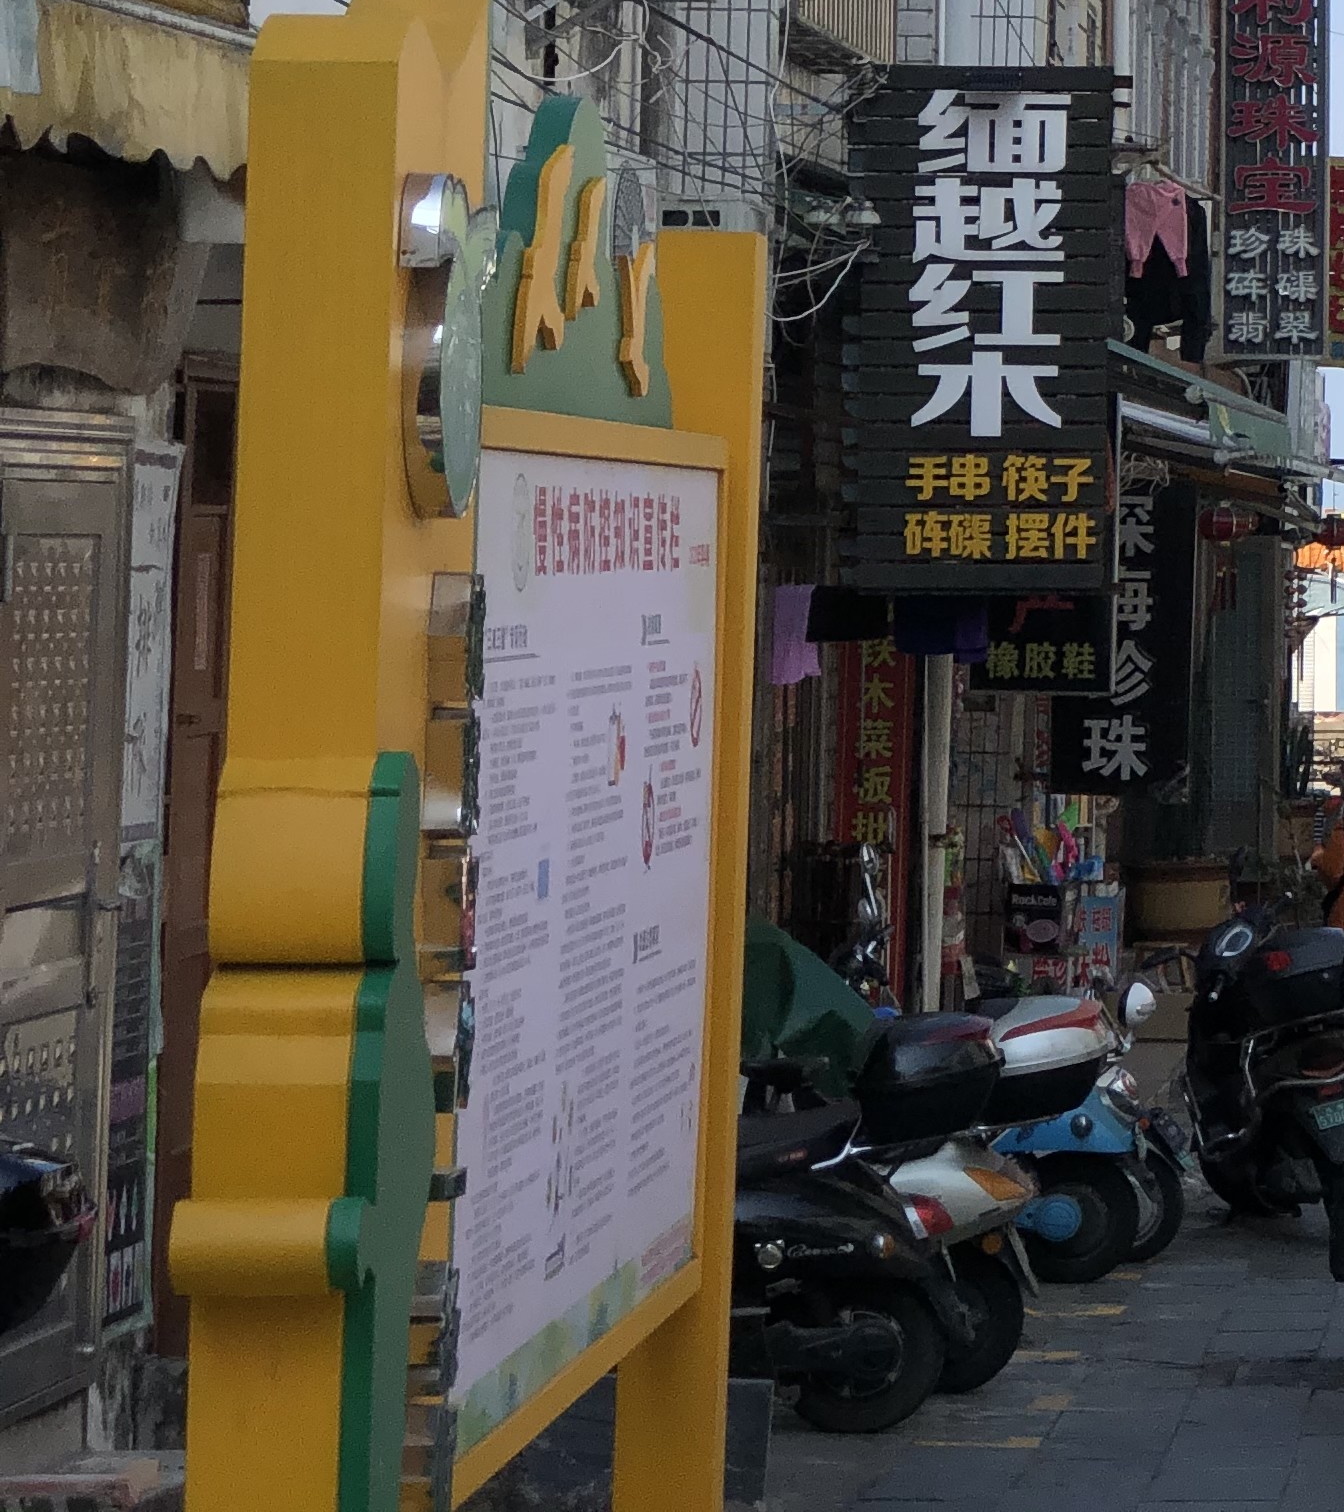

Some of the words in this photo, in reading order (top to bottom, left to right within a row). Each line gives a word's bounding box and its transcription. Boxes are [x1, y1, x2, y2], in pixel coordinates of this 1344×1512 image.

[1229, 224, 1319, 260] 珍珠
[909, 89, 1072, 437] 缅越红木
[1229, 271, 1319, 303] 砗磲
[1229, 311, 1320, 345] 翡翠
[905, 453, 991, 502] 手串
[1001, 454, 1094, 502] 筷子
[904, 511, 992, 559] 砗磲
[1005, 513, 1097, 560] 摆件
[985, 641, 1096, 680] 橡胶鞋
